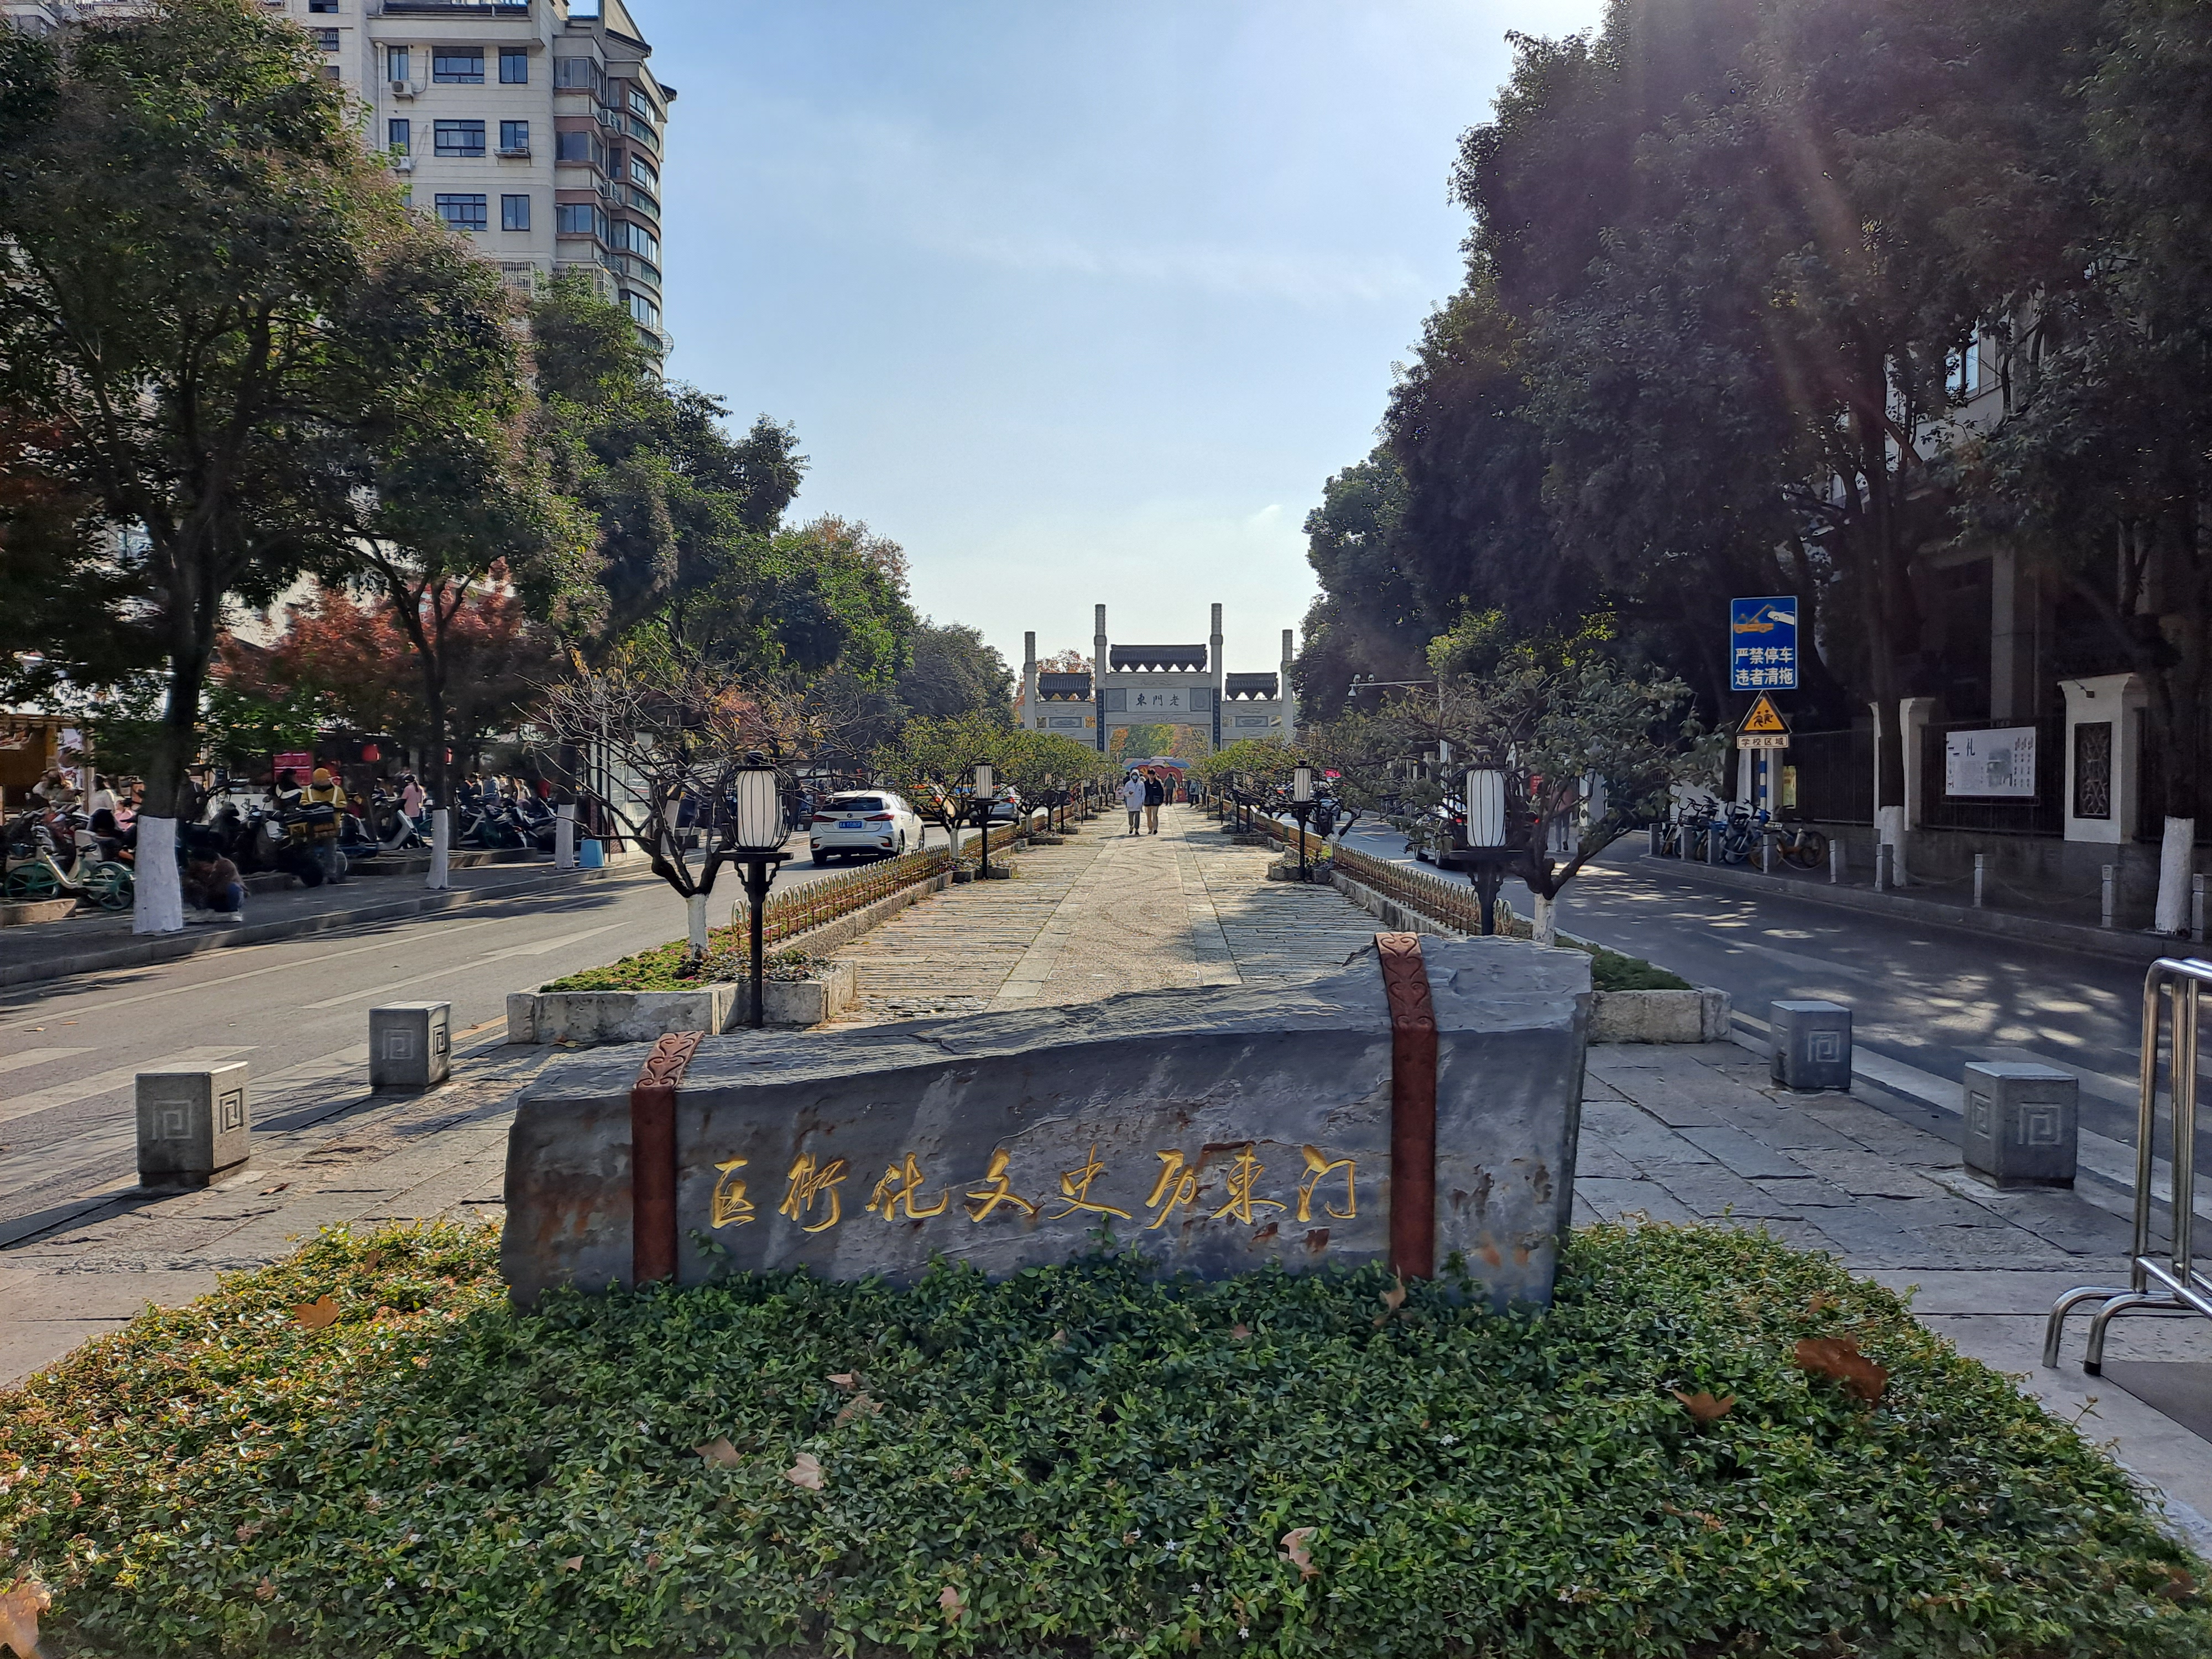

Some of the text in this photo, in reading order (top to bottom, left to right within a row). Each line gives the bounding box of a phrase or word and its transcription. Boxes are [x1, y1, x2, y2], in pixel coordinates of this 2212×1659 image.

[1735, 646, 1793, 664] 严禁停车
[1735, 667, 1793, 686] 违者清拖
[1741, 737, 1784, 747] 学校区域
